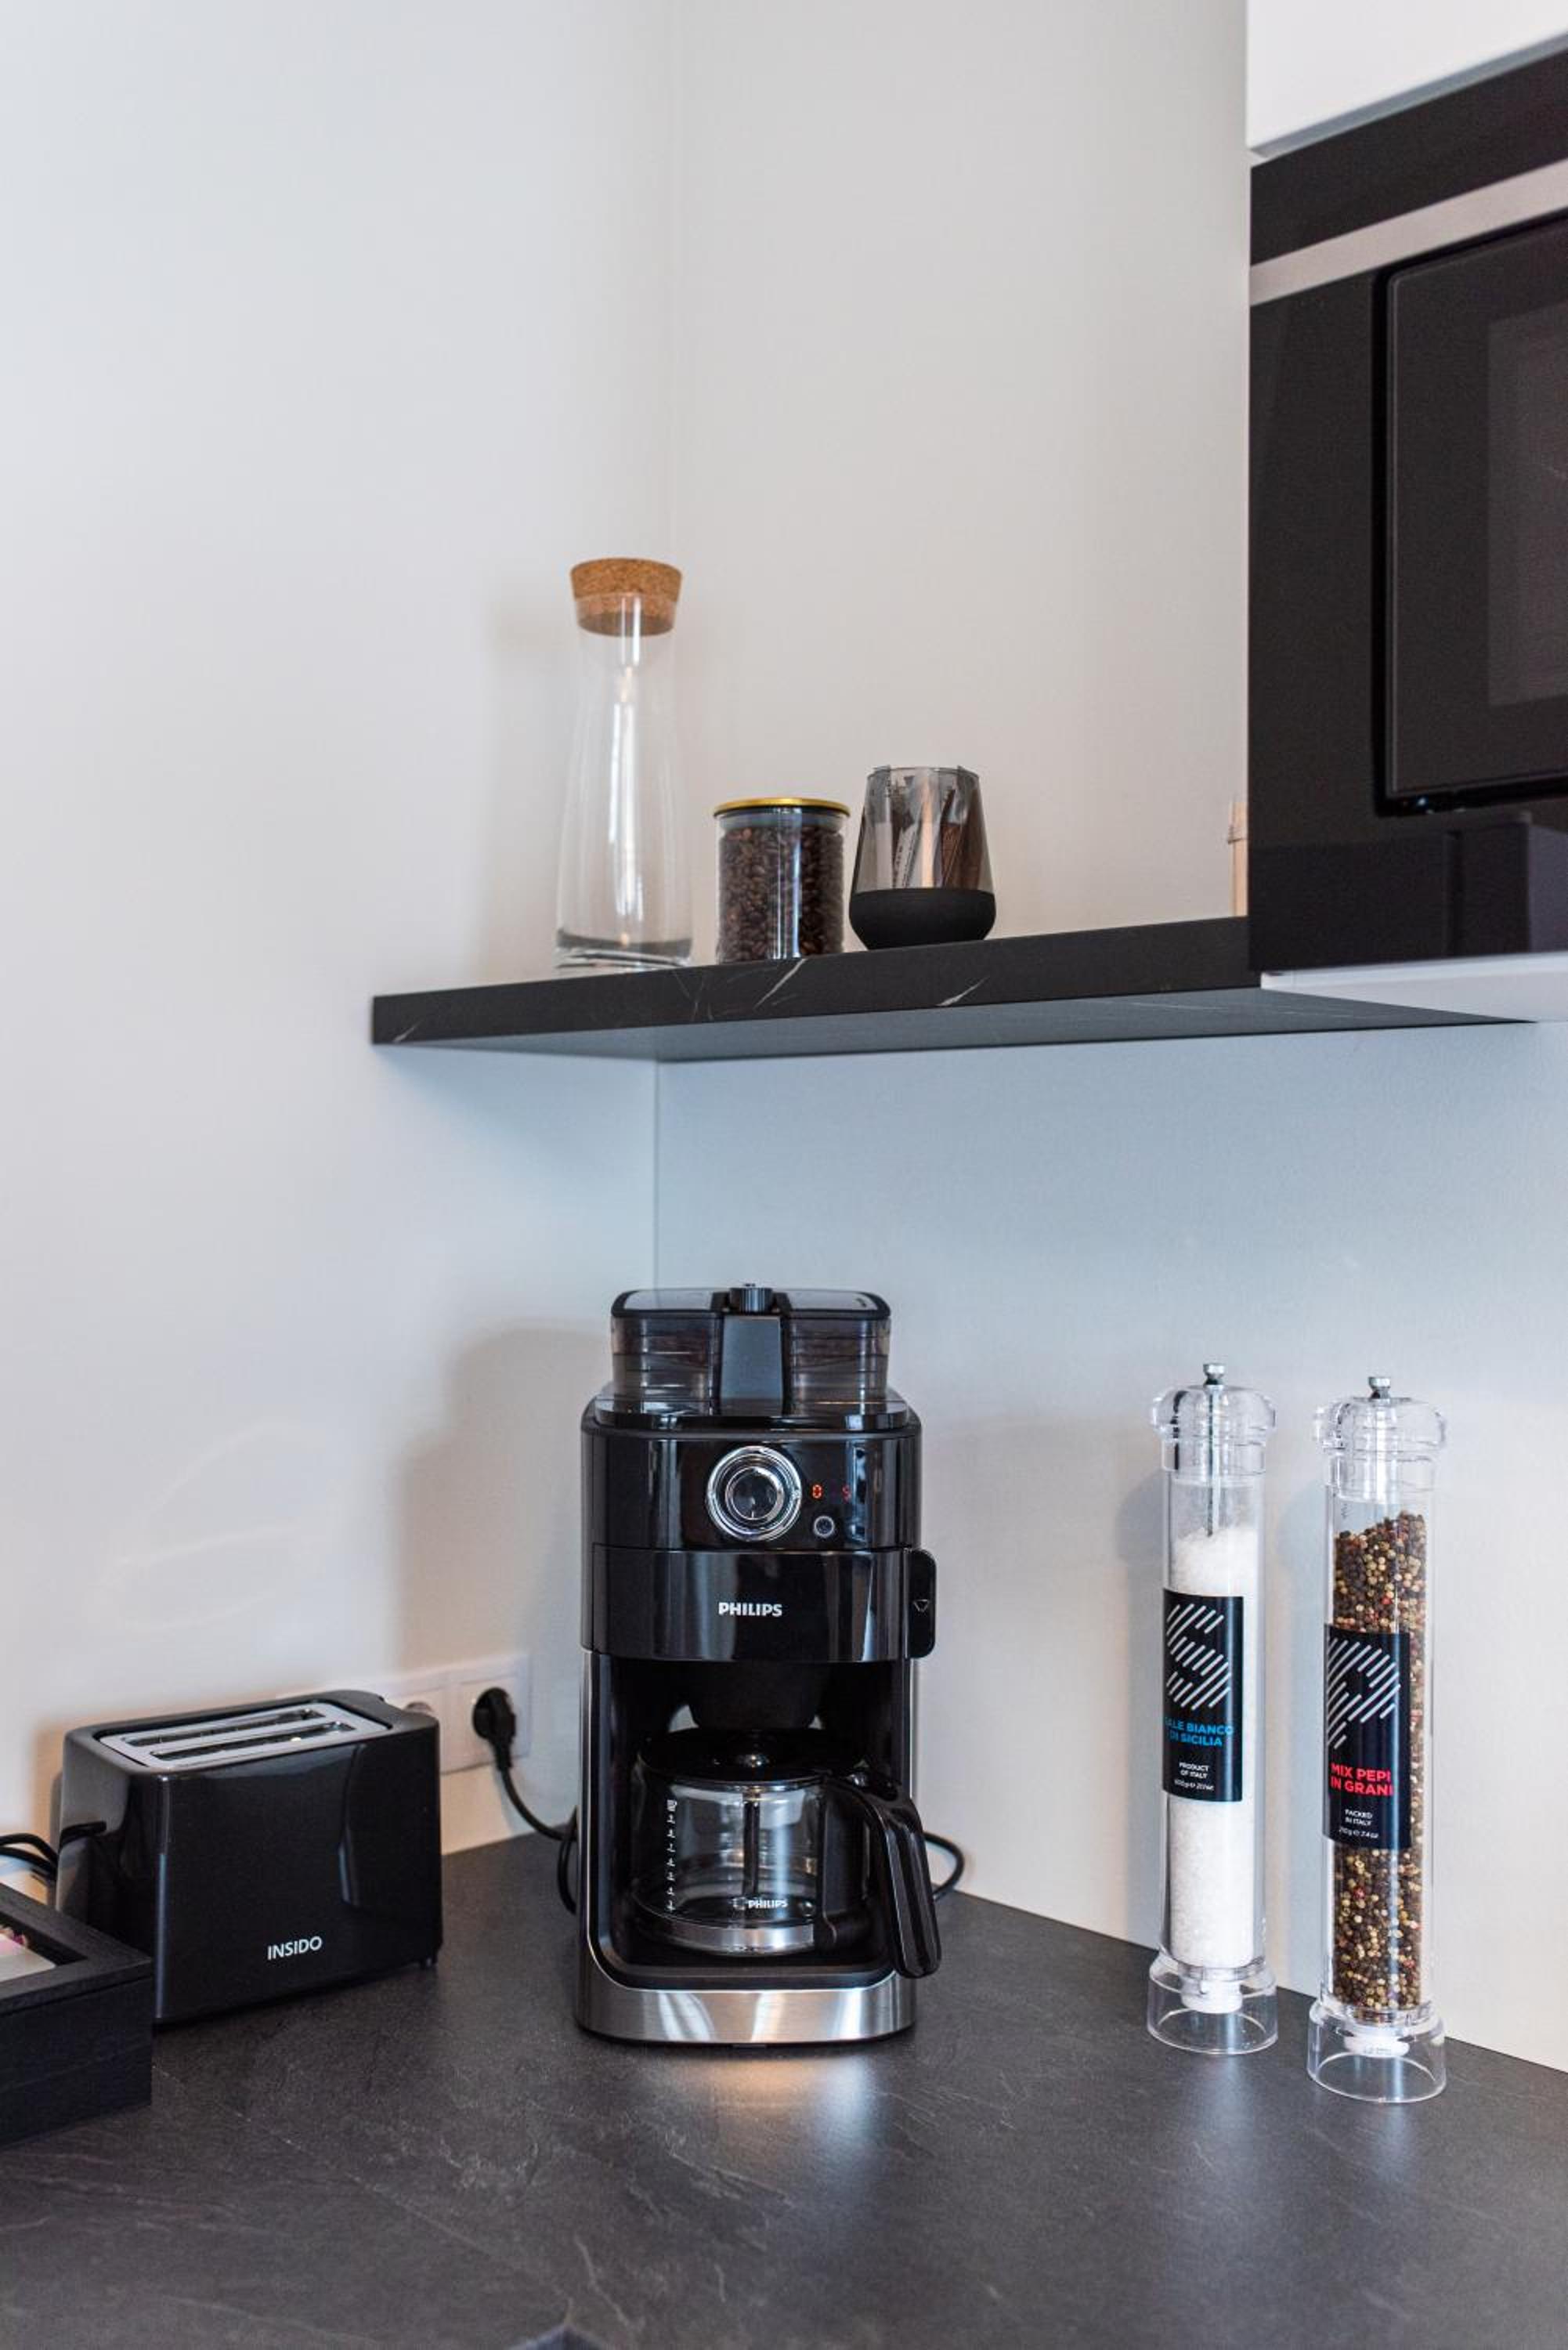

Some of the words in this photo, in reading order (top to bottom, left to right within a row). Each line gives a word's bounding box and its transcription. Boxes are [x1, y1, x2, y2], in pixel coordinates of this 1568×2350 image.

[718, 1602, 782, 1617] PHILIPS
[1187, 1723, 1234, 1736] BIANCO
[1180, 1733, 1223, 1748] SICILIA
[1179, 1762, 1209, 1772] PRODUCT
[1330, 1762, 1353, 1778] MIX
[1356, 1768, 1392, 1783] PEPI
[1330, 1776, 1342, 1790] IN
[1344, 1781, 1393, 1796] GRANI
[1345, 1809, 1373, 1820] PACKED
[748, 1899, 789, 1909] PHILIPS
[267, 1936, 323, 1961] INSIDO
